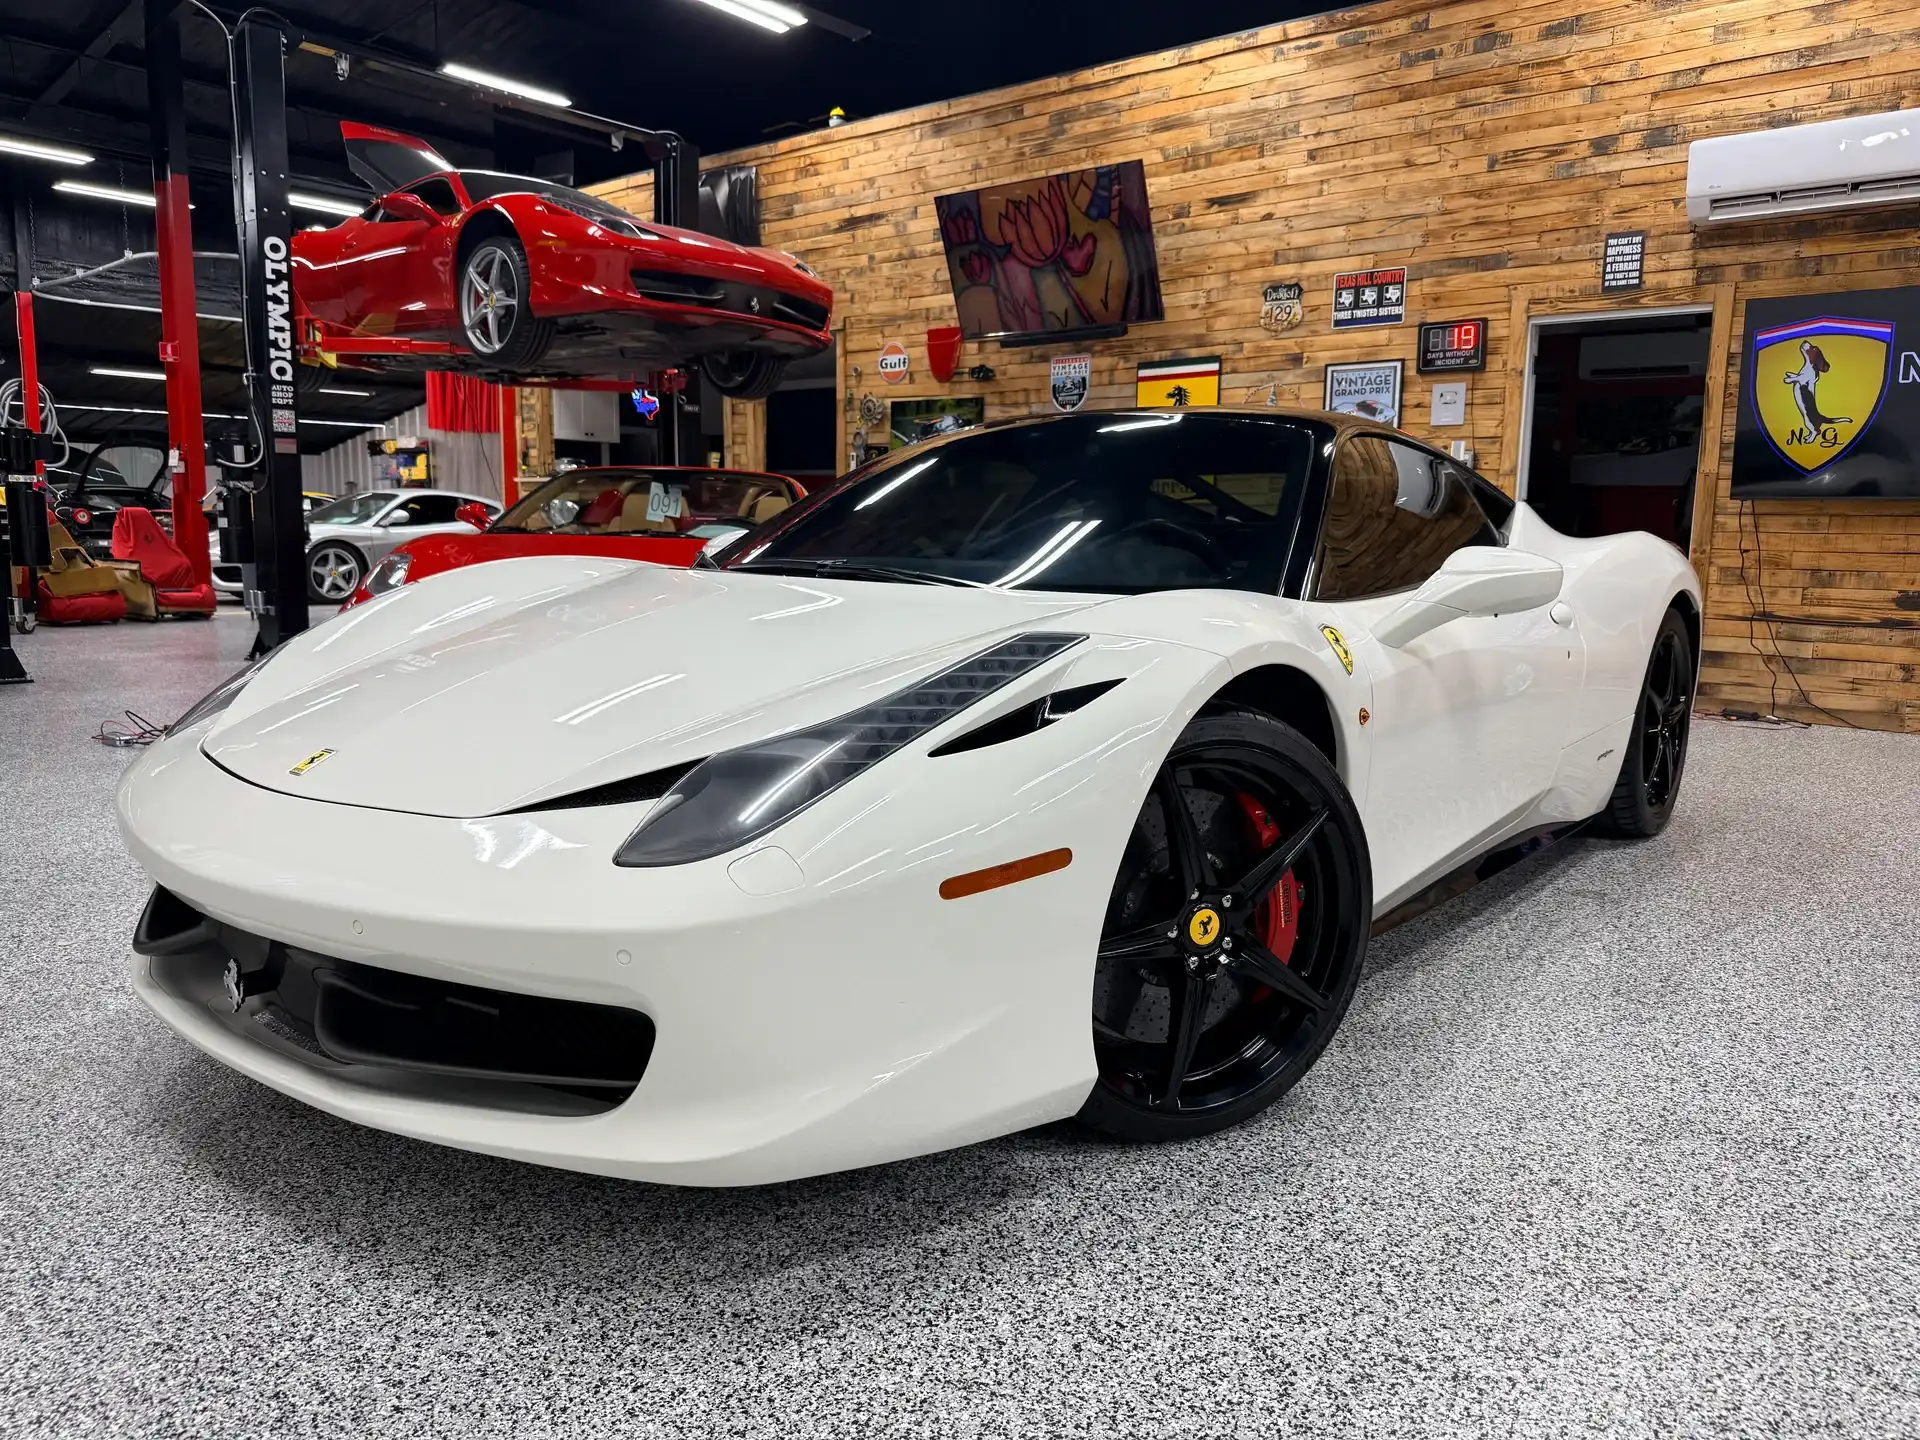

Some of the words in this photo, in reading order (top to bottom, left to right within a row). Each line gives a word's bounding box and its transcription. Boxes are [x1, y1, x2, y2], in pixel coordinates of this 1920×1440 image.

[1618, 237, 1632, 245] CAN'T
[1607, 244, 1641, 255] HAPPINESS
[1606, 264, 1611, 272] A
[1612, 261, 1640, 271] FERRARI
[1336, 275, 1357, 289] TEXAS
[1357, 272, 1372, 287] HILL
[1373, 269, 1405, 285] COUNTRY
[264, 236, 293, 381] OLYMPIC
[1269, 304, 1292, 322] 129
[1333, 309, 1352, 320] THREE
[1352, 307, 1378, 319] TWISTED
[1378, 305, 1404, 317] SISTERS
[1445, 350, 1475, 358] WITHOUT
[880, 357, 908, 370] Gulf
[1052, 363, 1089, 371] VINTAGE
[1434, 358, 1465, 366] INCIDENT
[1335, 374, 1392, 389] VINTAGE
[1334, 387, 1367, 397] GRAND
[1368, 386, 1391, 395] PRIX
[650, 493, 680, 516] 091
